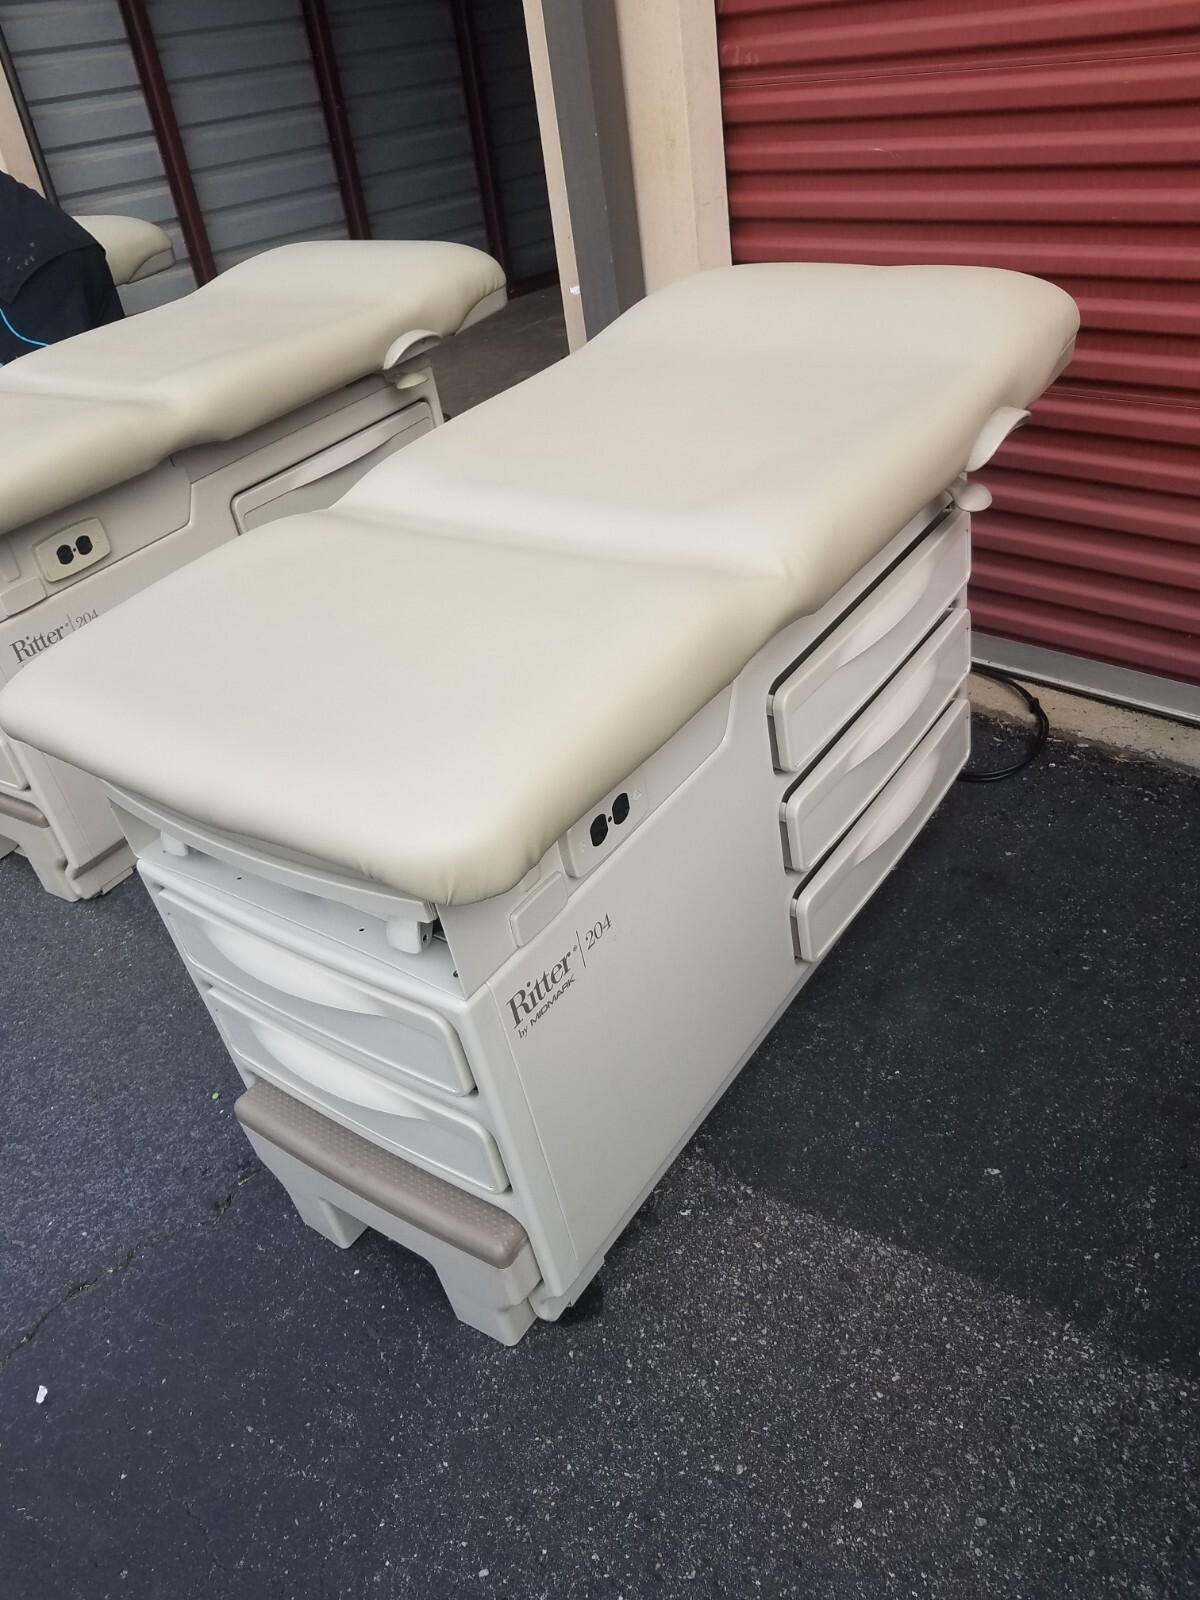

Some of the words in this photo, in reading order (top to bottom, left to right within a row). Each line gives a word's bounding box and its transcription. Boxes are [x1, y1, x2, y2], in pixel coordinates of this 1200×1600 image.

[75, 608, 99, 628] 204
[585, 912, 612, 950] 204
[518, 1026, 528, 1039] by
[529, 973, 576, 1026] MIDMARK
